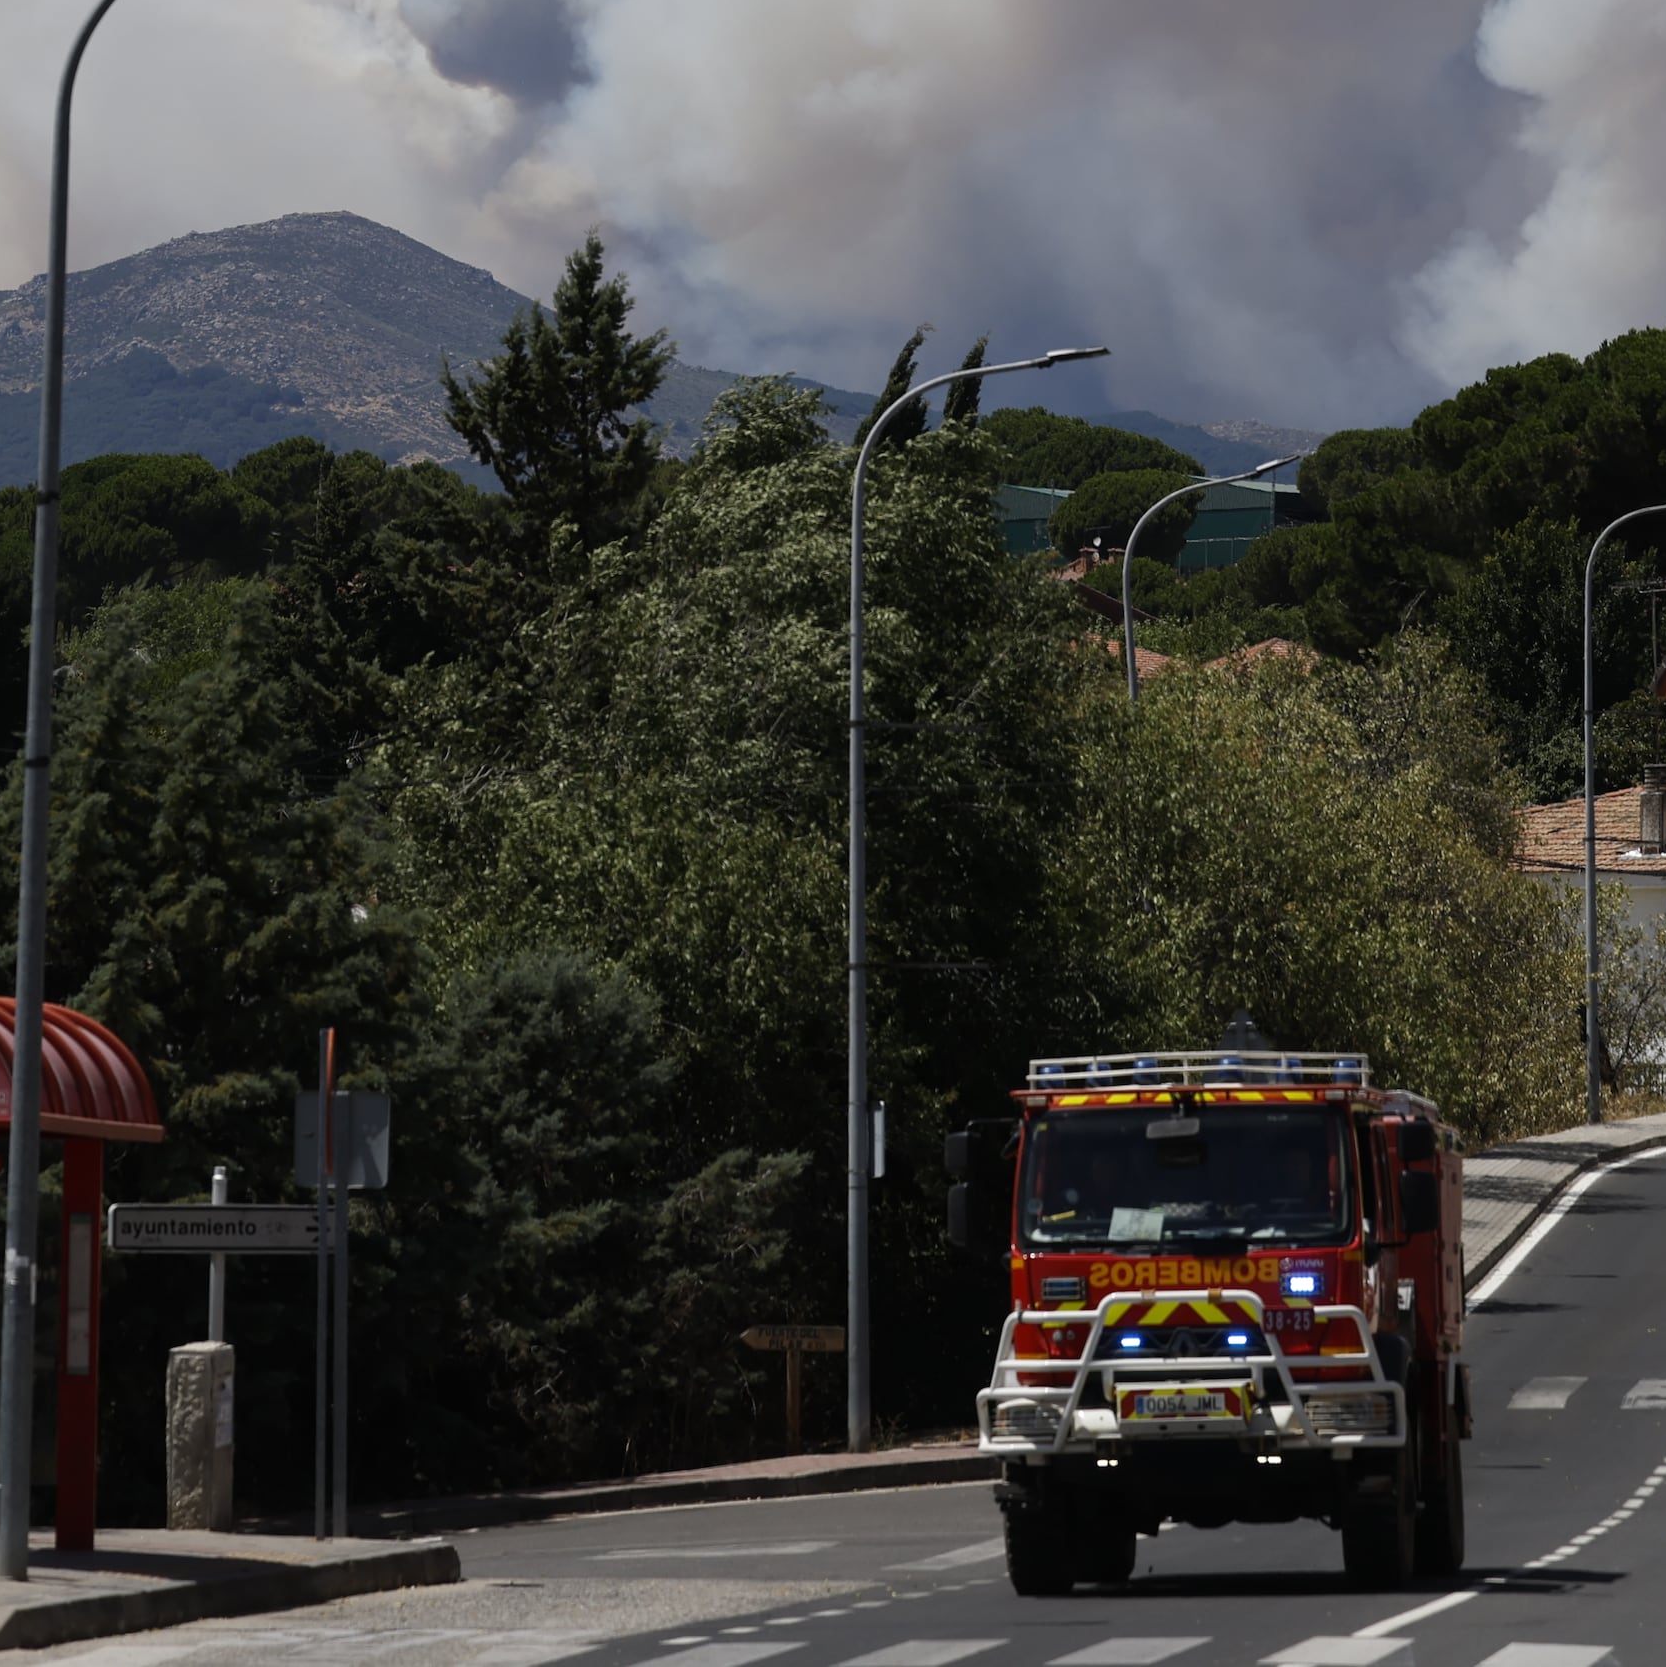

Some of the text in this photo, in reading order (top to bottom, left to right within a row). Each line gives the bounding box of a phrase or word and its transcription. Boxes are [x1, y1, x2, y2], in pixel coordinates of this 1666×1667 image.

[121, 1218, 257, 1239] ayuntamiento
[1266, 1310, 1310, 1330] 38-25
[769, 1339, 802, 1349] PILAR
[1147, 1394, 1221, 1412] 0054 JML
